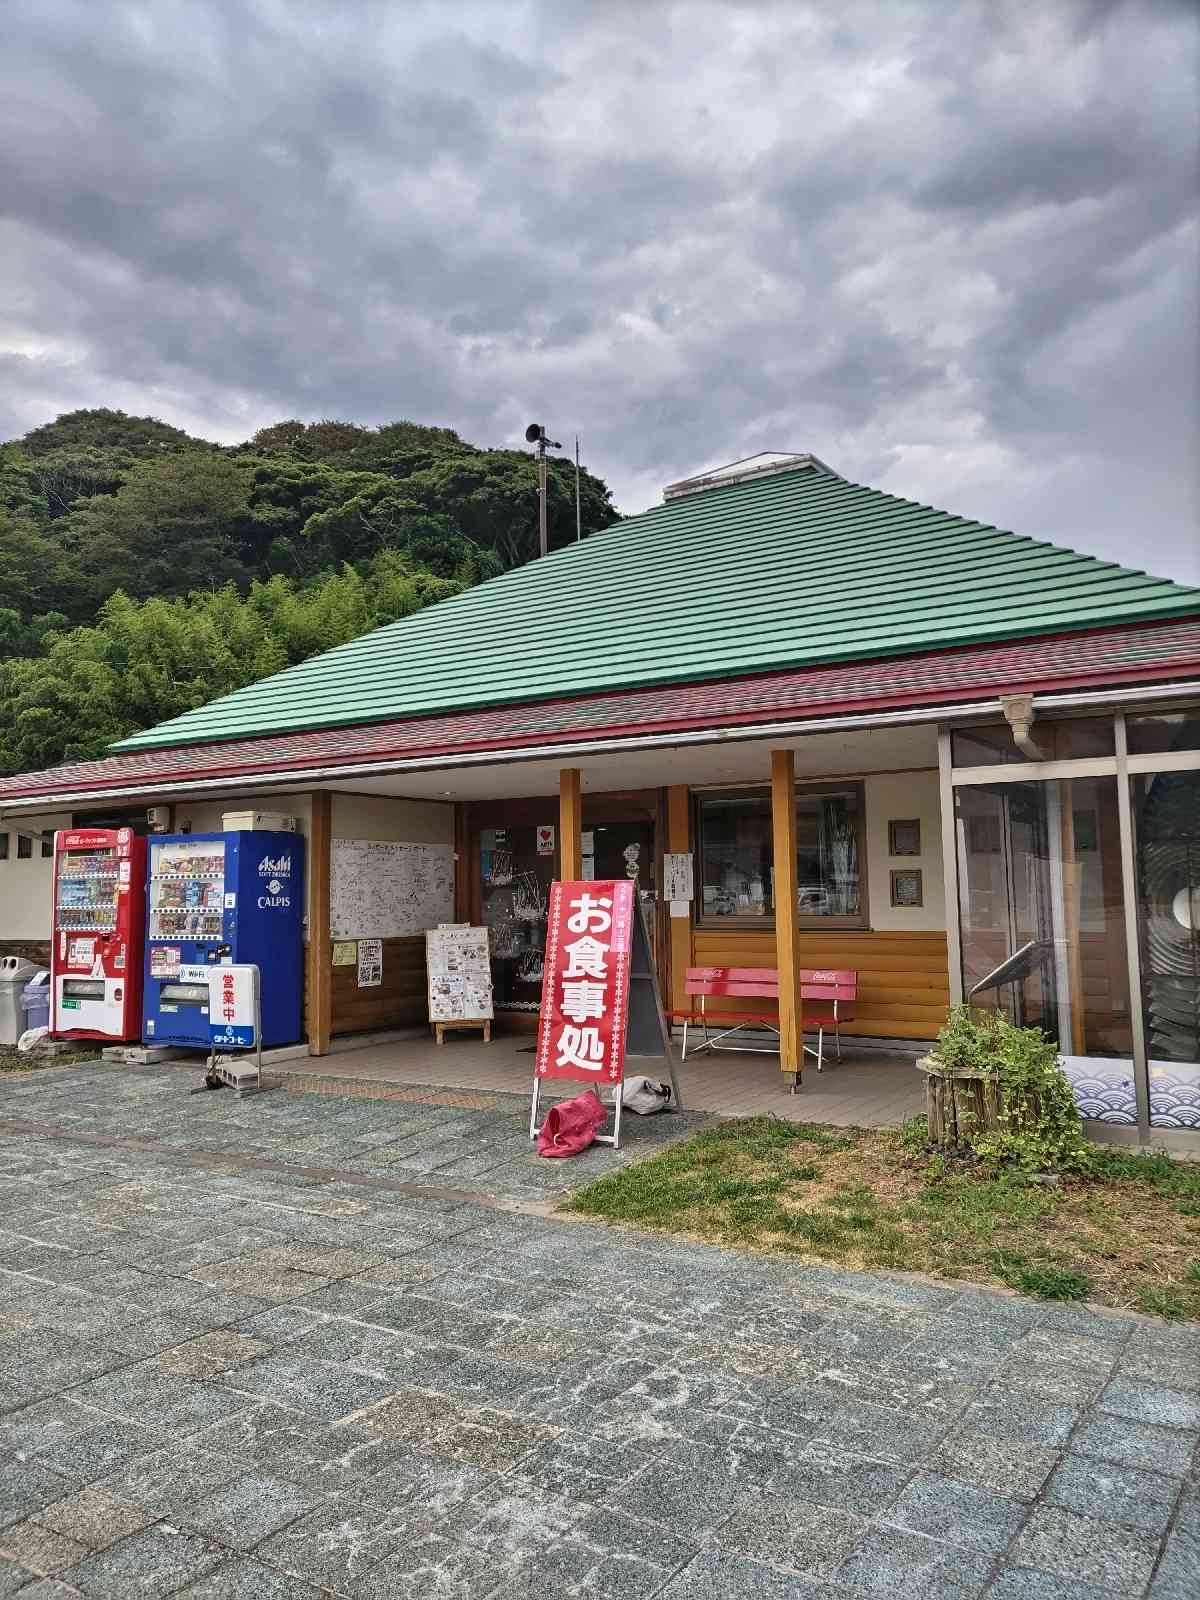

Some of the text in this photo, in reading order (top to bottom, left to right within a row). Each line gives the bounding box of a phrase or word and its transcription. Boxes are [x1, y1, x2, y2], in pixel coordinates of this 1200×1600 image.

[258, 855, 291, 872] Asahi
[257, 896, 291, 909] CALPIS
[222, 972, 235, 1022] 営業中
[555, 892, 613, 1071] お食事処
